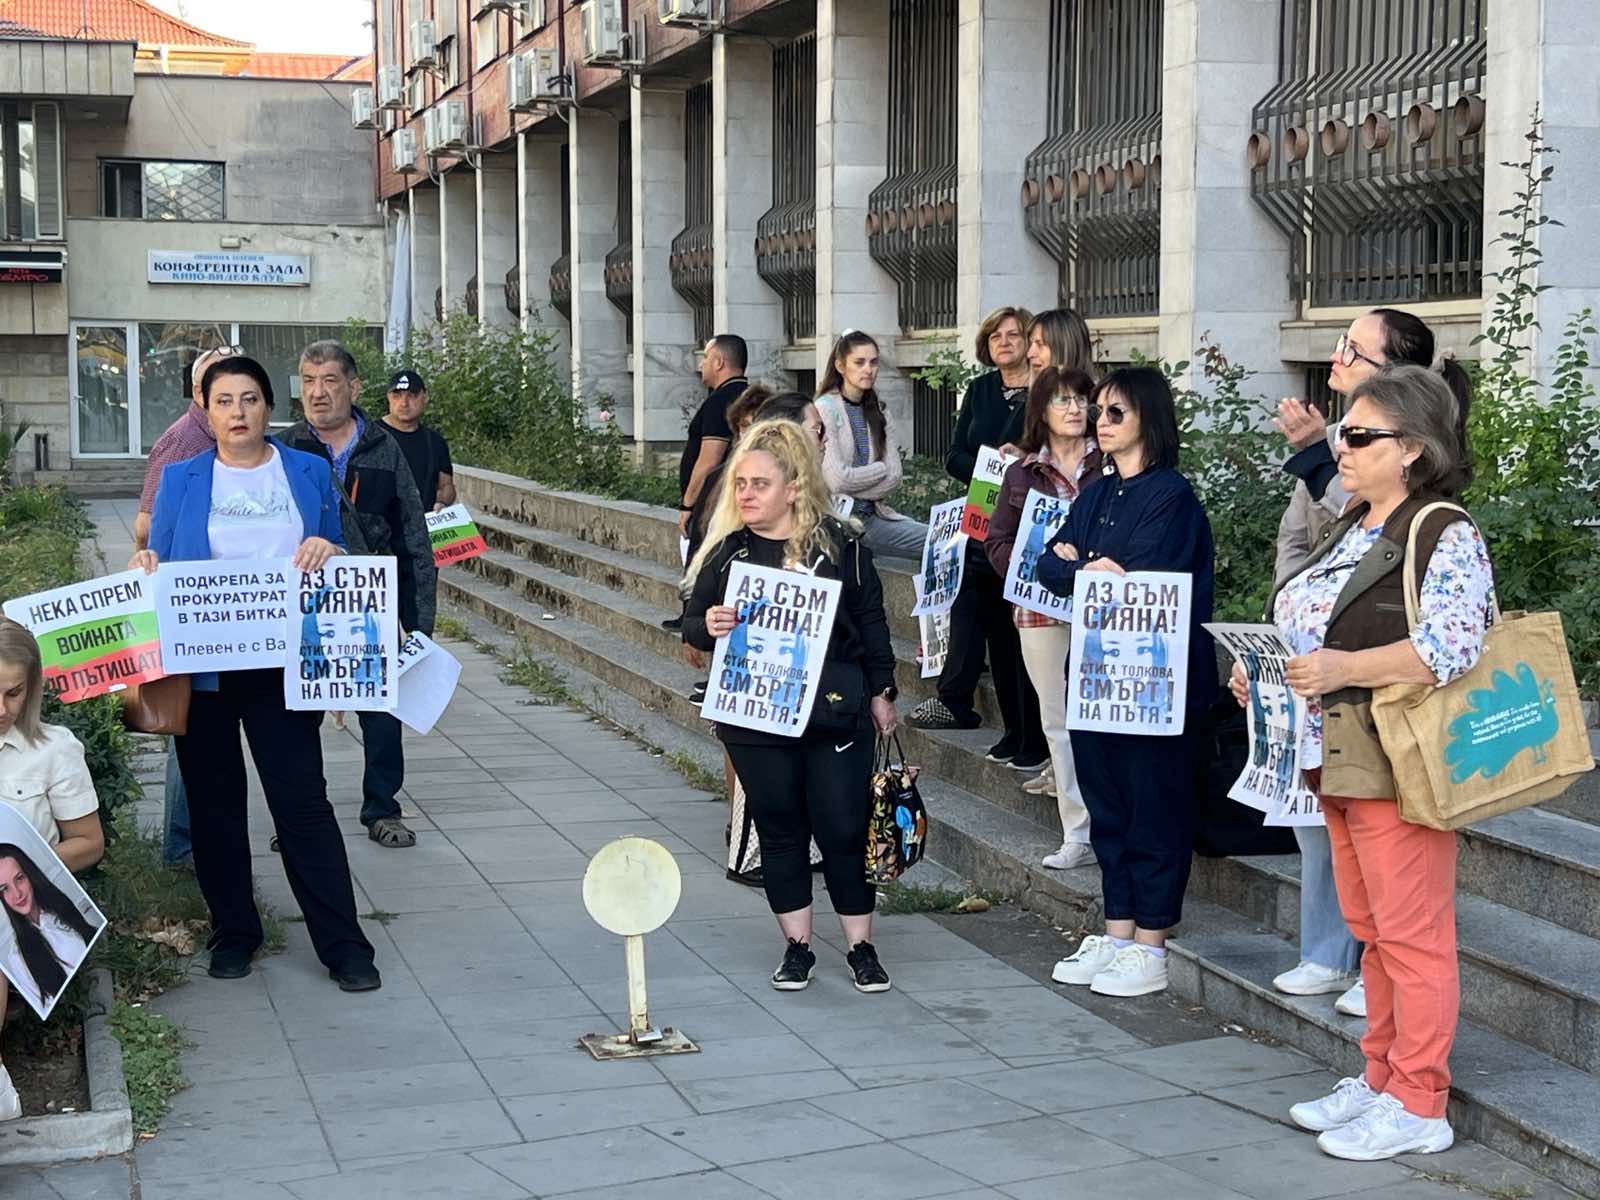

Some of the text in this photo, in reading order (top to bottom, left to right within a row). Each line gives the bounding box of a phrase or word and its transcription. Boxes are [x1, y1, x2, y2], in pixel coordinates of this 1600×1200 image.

[153, 262, 304, 274] КОНФЕРЕНТНА ЗАЛА
[172, 272, 284, 282] КИНО-ВИДЕО КЛУБ
[985, 458, 1006, 478] НЕК
[1034, 497, 1060, 511] АЗ
[431, 529, 459, 544] ЙНАТА
[174, 572, 286, 590] ПОДКРЕПА ЗА
[300, 567, 387, 590] АЗ СЪМ
[170, 590, 287, 607] ПРОКУРАТУРАТ
[736, 574, 828, 613] АЗ СЪМ
[1013, 581, 1033, 601] НА
[1084, 581, 1179, 608] АЗ СЪМ
[29, 580, 143, 625] НЕКА СПРЕМ
[300, 590, 387, 615] СИЯНА!
[178, 607, 288, 624] В ТАЗИ БИТКА
[733, 598, 823, 639] СИЯНА!
[1083, 604, 1178, 634] СИЯНА!
[56, 620, 137, 656] ВОЙНАТА
[174, 638, 287, 657] Плевен е с Ва
[1221, 631, 1291, 658] АЗ СЪМ
[300, 643, 386, 657] СТИГА ТОЛКОВА
[71, 650, 160, 691] ПЪТИЩАТ
[723, 653, 809, 682] СТИГА ТОЛКОВА
[1080, 663, 1174, 679] СТИГА ТОЛКОВА
[301, 682, 322, 700] НА
[715, 693, 738, 714] НА
[1079, 702, 1101, 721] НА
[1243, 768, 1261, 793] НА
